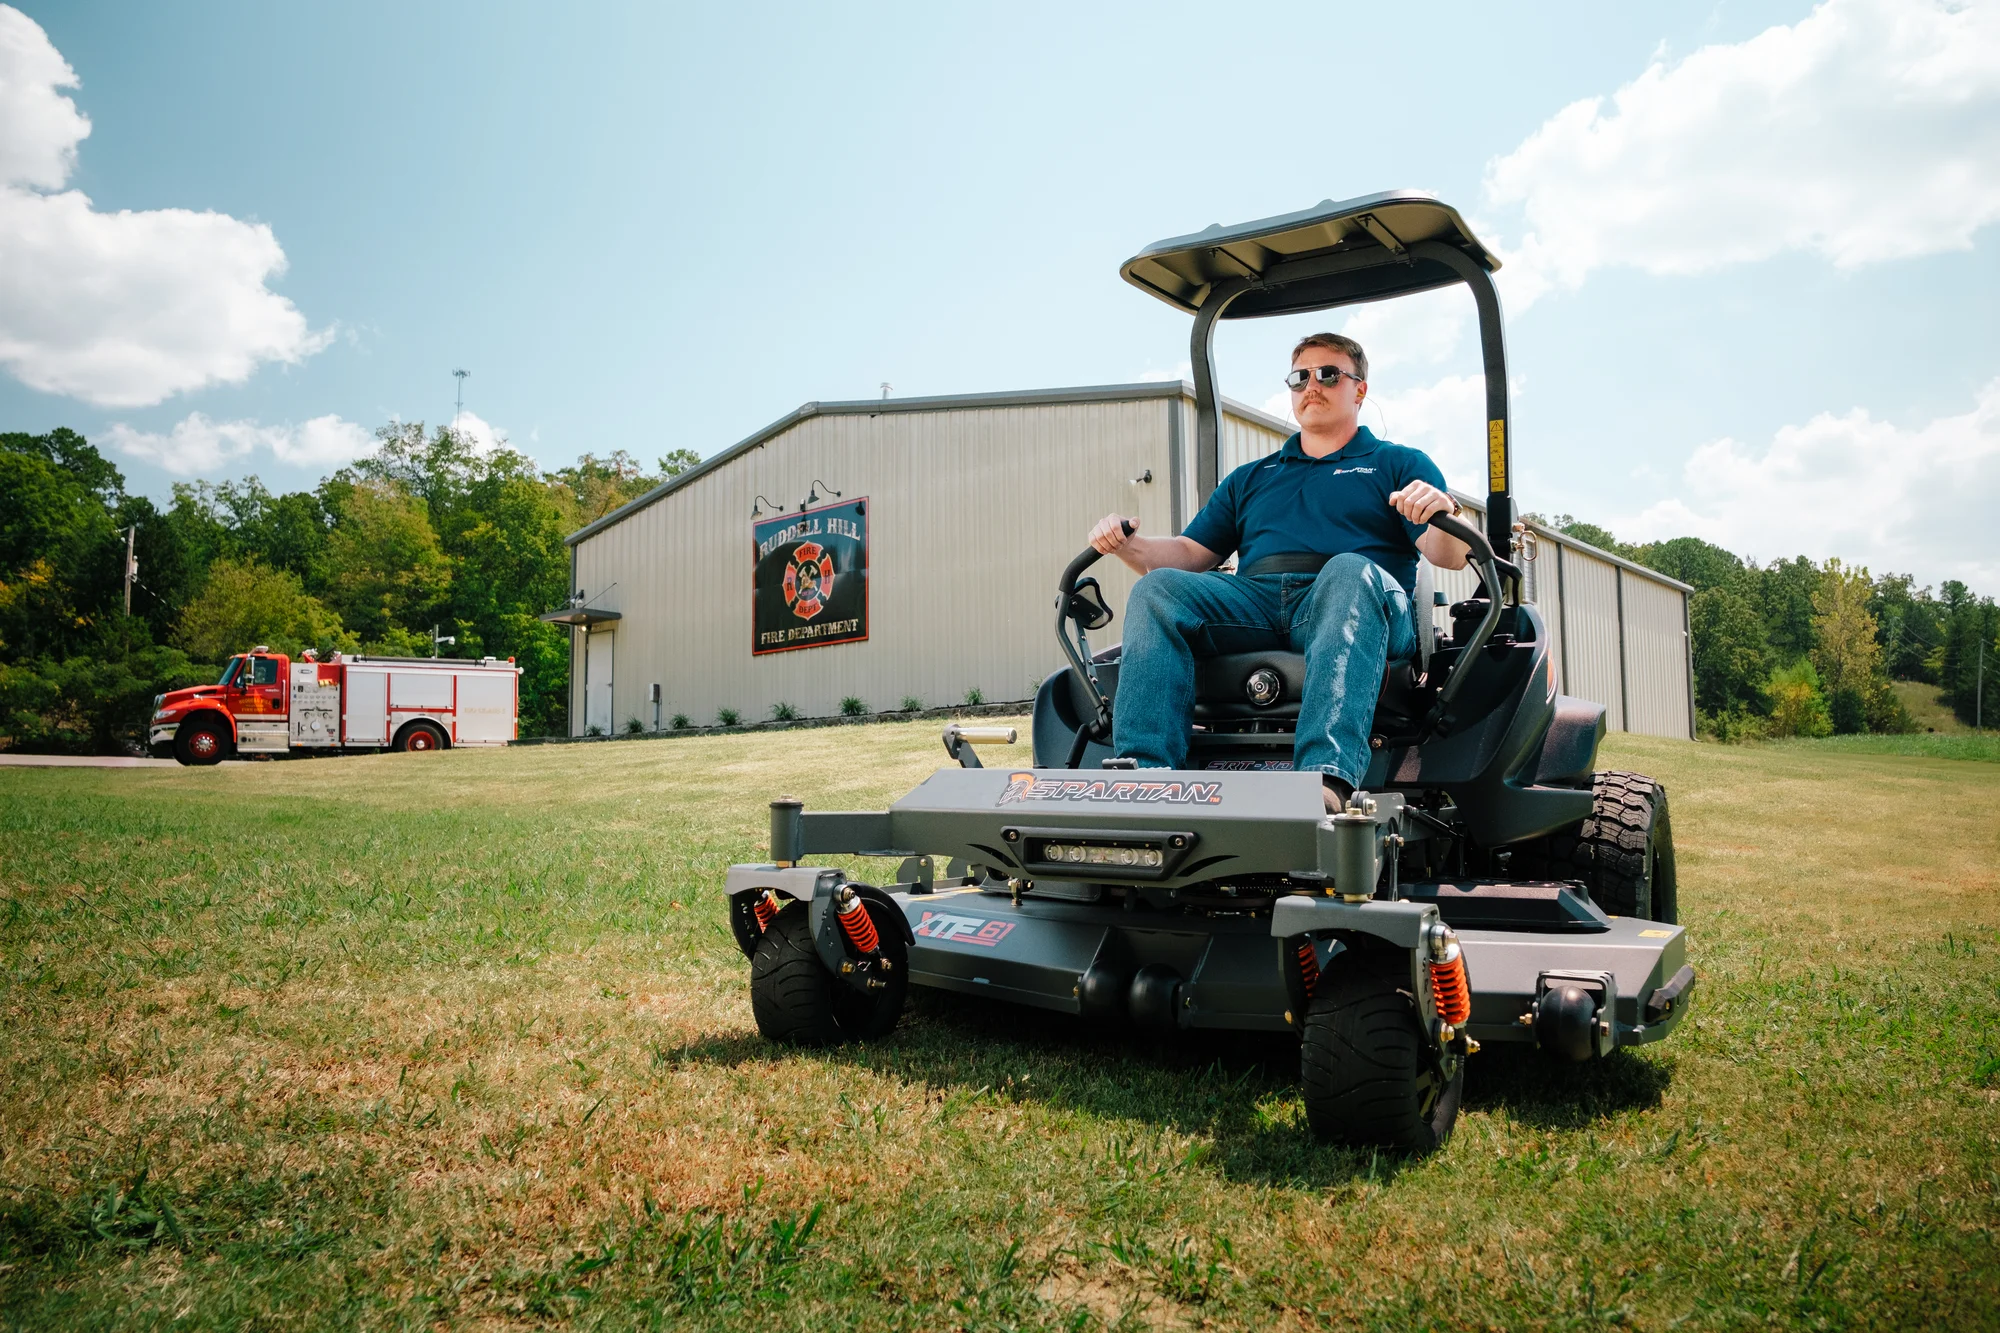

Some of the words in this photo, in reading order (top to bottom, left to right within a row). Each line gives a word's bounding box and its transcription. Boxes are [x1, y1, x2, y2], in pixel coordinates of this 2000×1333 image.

[760, 518, 822, 560] RUDDELL
[827, 517, 861, 541] HILL
[799, 547, 816, 558] FIRE
[786, 577, 793, 591] R
[824, 570, 831, 584] H
[799, 603, 817, 613] DEPT
[761, 630, 785, 645] FIRE
[788, 618, 859, 641] DEPARTMENT
[1027, 781, 1220, 802] SPARTAN
[977, 920, 1016, 940] 61
